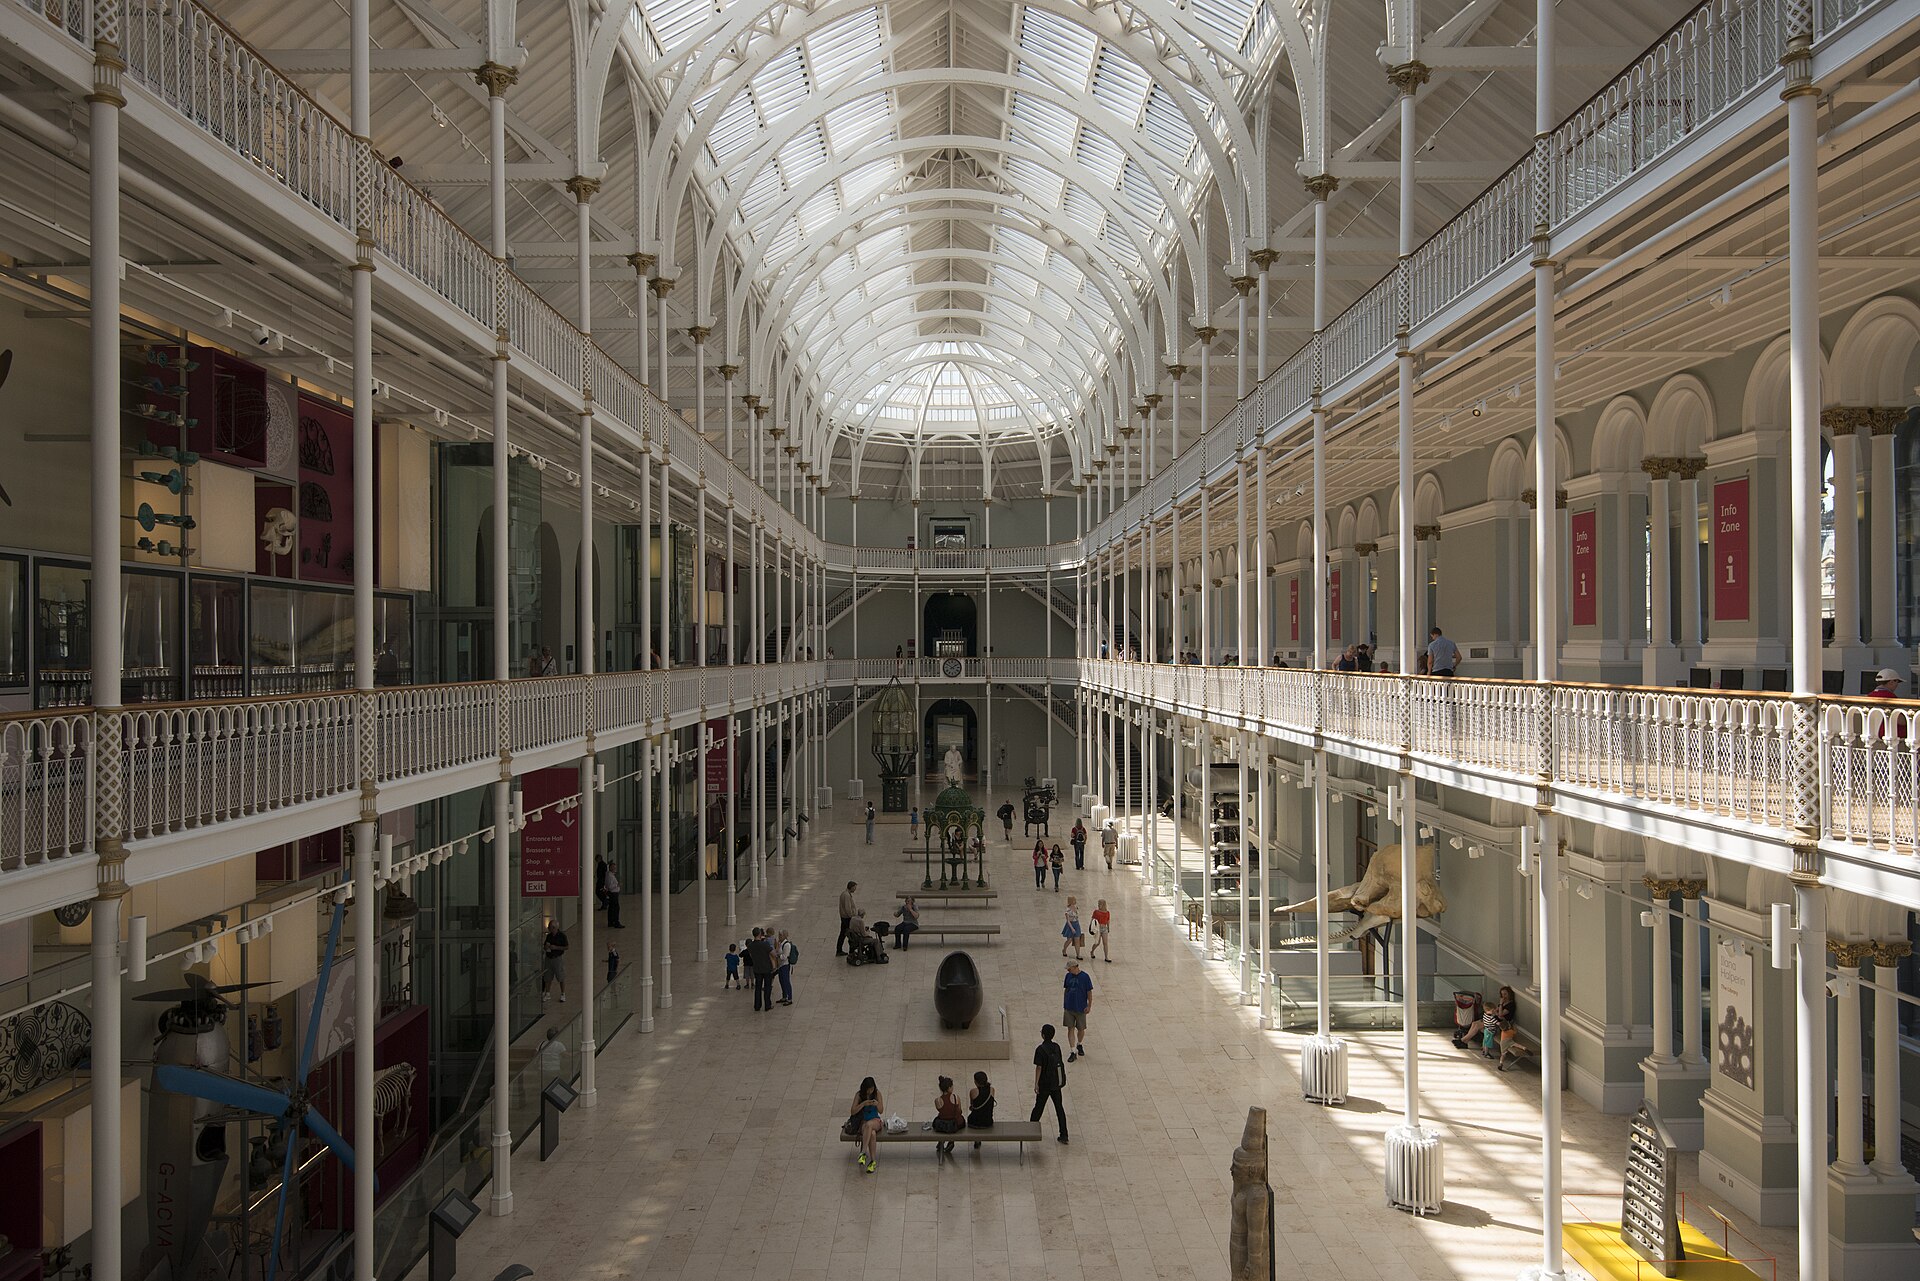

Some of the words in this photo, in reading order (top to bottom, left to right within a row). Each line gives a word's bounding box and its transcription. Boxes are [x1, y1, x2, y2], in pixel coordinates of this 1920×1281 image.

[1720, 503, 1737, 517] Info
[1720, 521, 1740, 533] Zone
[1576, 531, 1588, 542] Info
[1576, 545, 1590, 555] Zone
[1720, 967, 1746, 986] Halperin
[157, 1162, 175, 1247] G-ACVA
